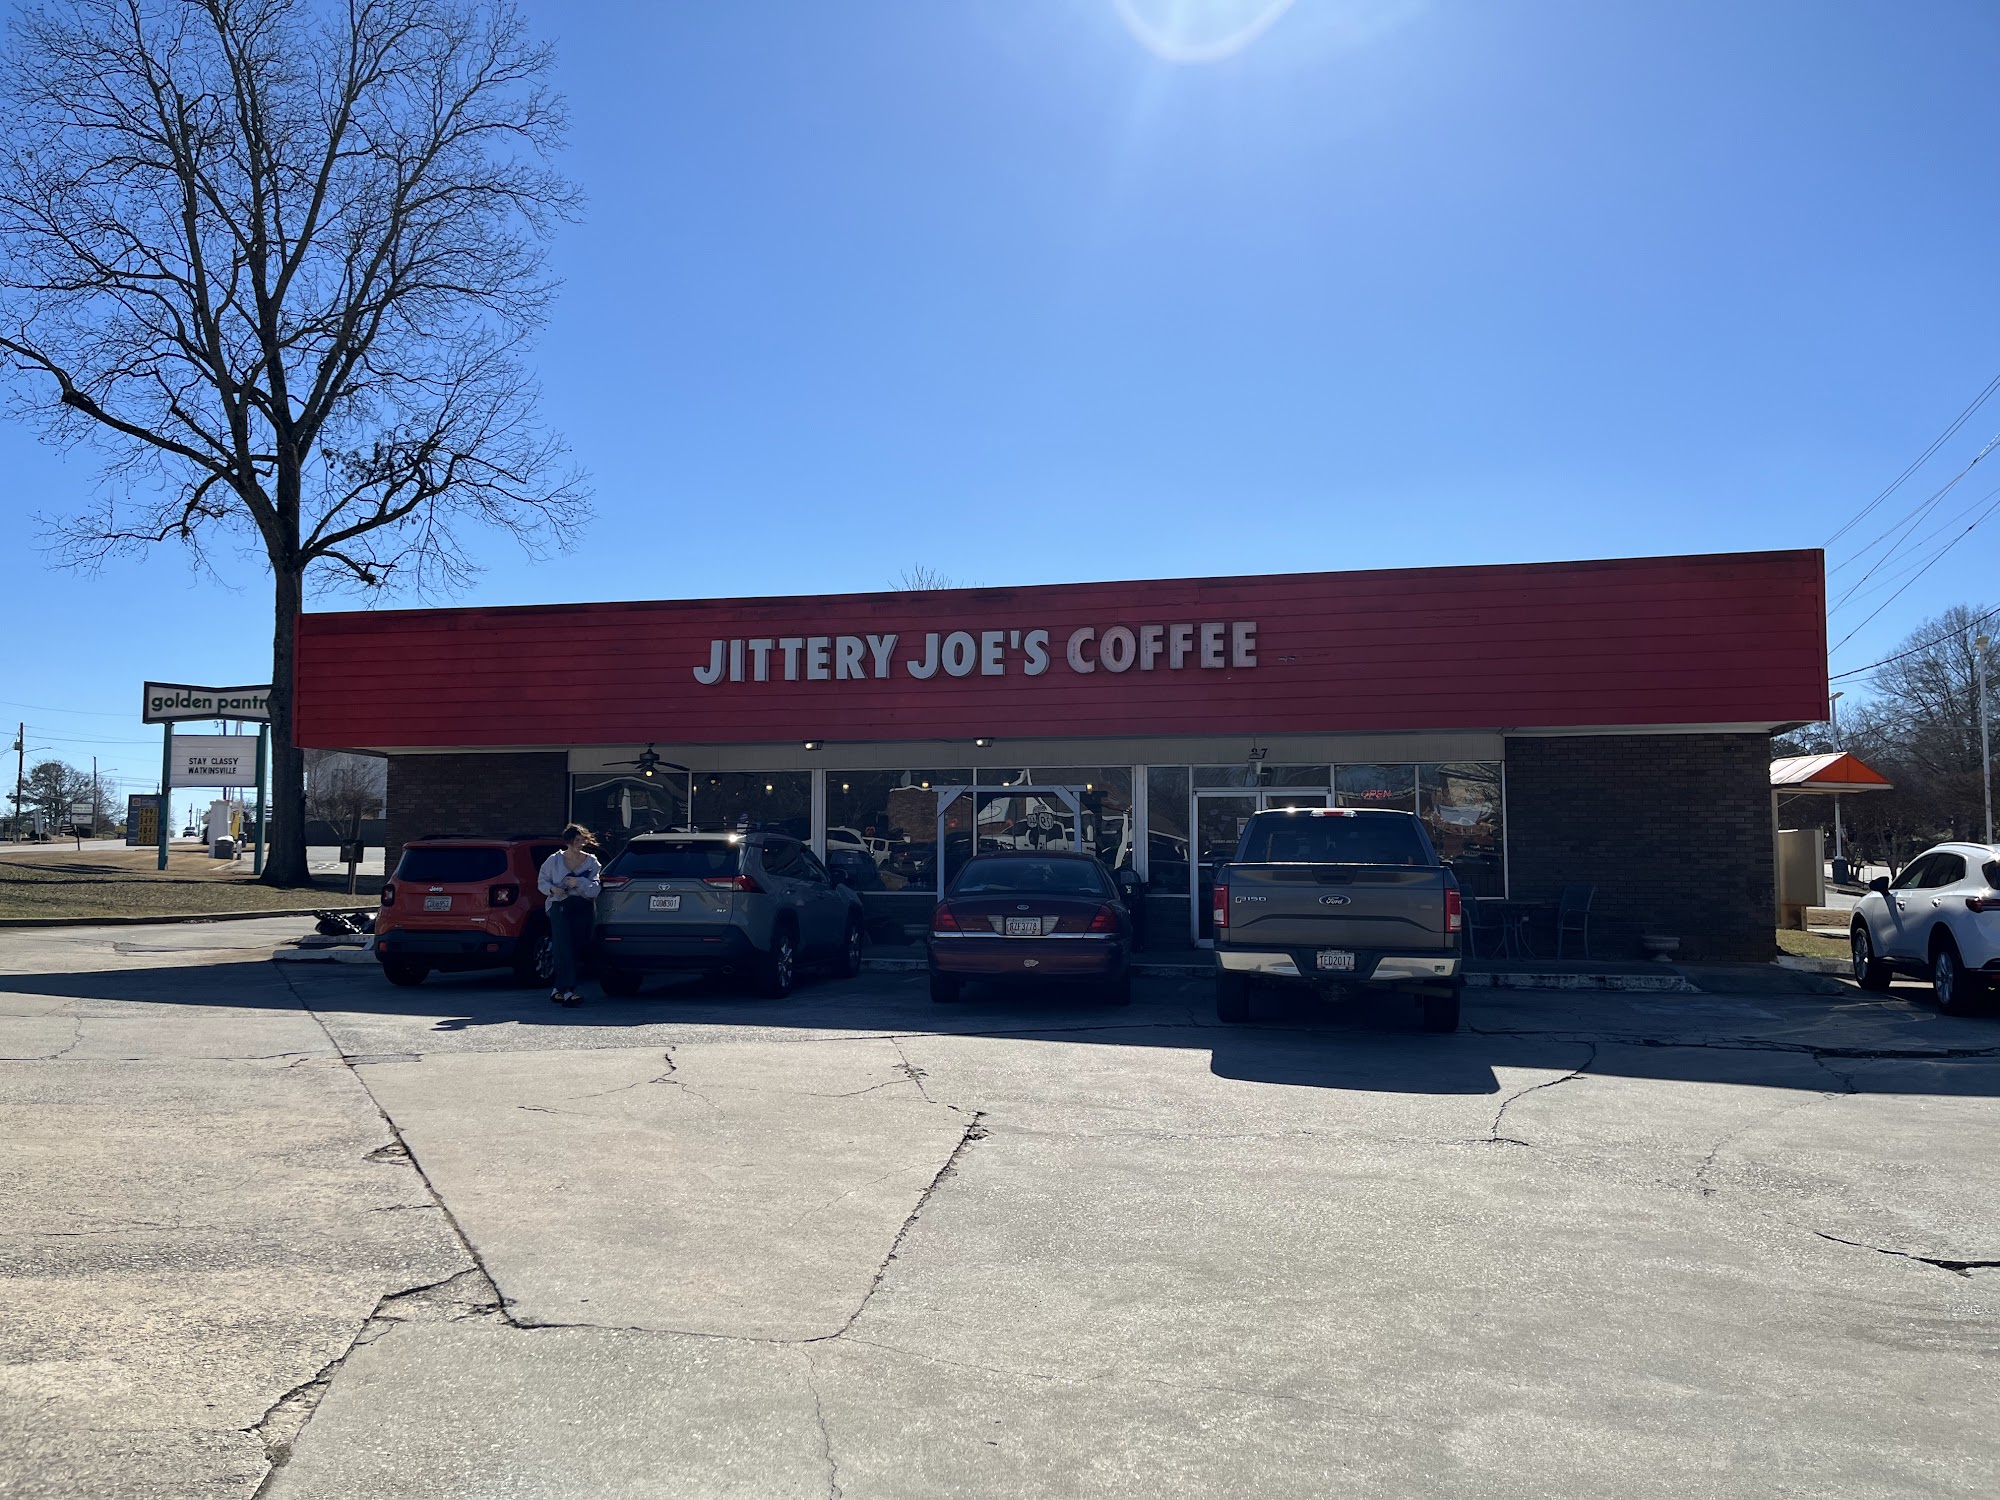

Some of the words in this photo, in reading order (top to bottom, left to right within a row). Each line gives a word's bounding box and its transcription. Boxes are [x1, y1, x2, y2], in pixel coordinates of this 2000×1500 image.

[693, 634, 898, 686] JITTERY
[907, 629, 1050, 680] JOE'S
[1066, 621, 1258, 674] COFFEE
[151, 690, 212, 712] golden
[217, 695, 268, 714] pantr
[188, 757, 207, 765] STAY
[211, 757, 239, 765] CLASSY
[188, 767, 237, 775] WATKINSVILLE
[1361, 789, 1392, 799] OPEN
[1320, 955, 1351, 966] TED2017
